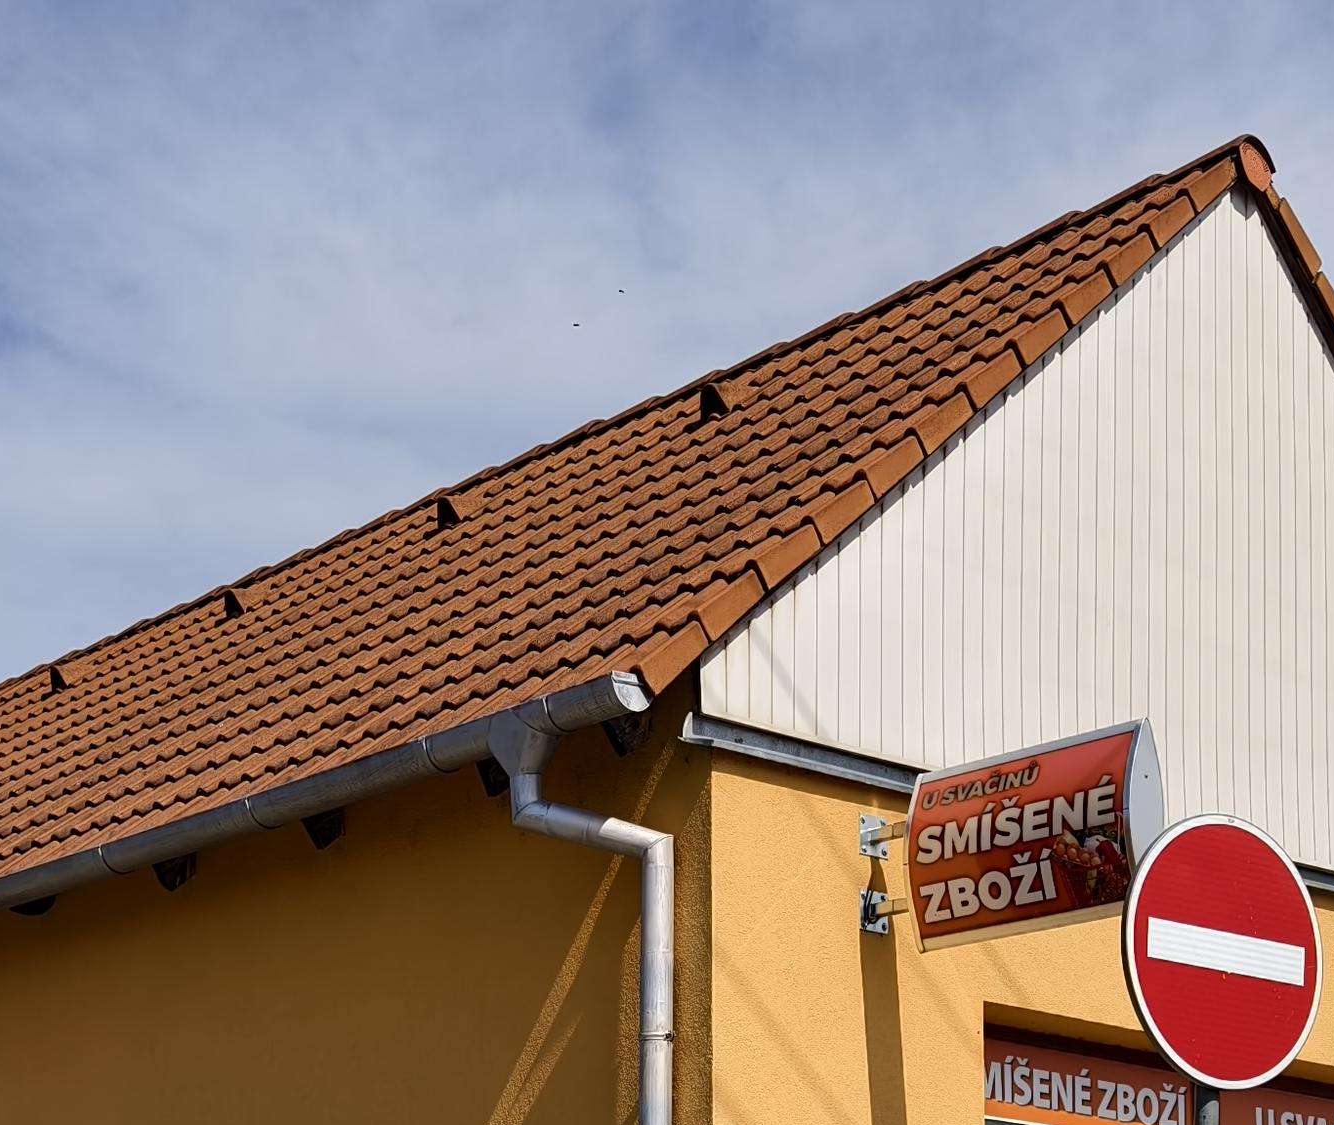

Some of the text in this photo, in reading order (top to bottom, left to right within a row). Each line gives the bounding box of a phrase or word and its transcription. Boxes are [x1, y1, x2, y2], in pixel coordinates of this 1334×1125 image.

[916, 774, 1116, 864] SMÍŠENÉ
[922, 760, 1040, 810] U SVAČINŮ
[919, 848, 1057, 923] ZBOŽÍ
